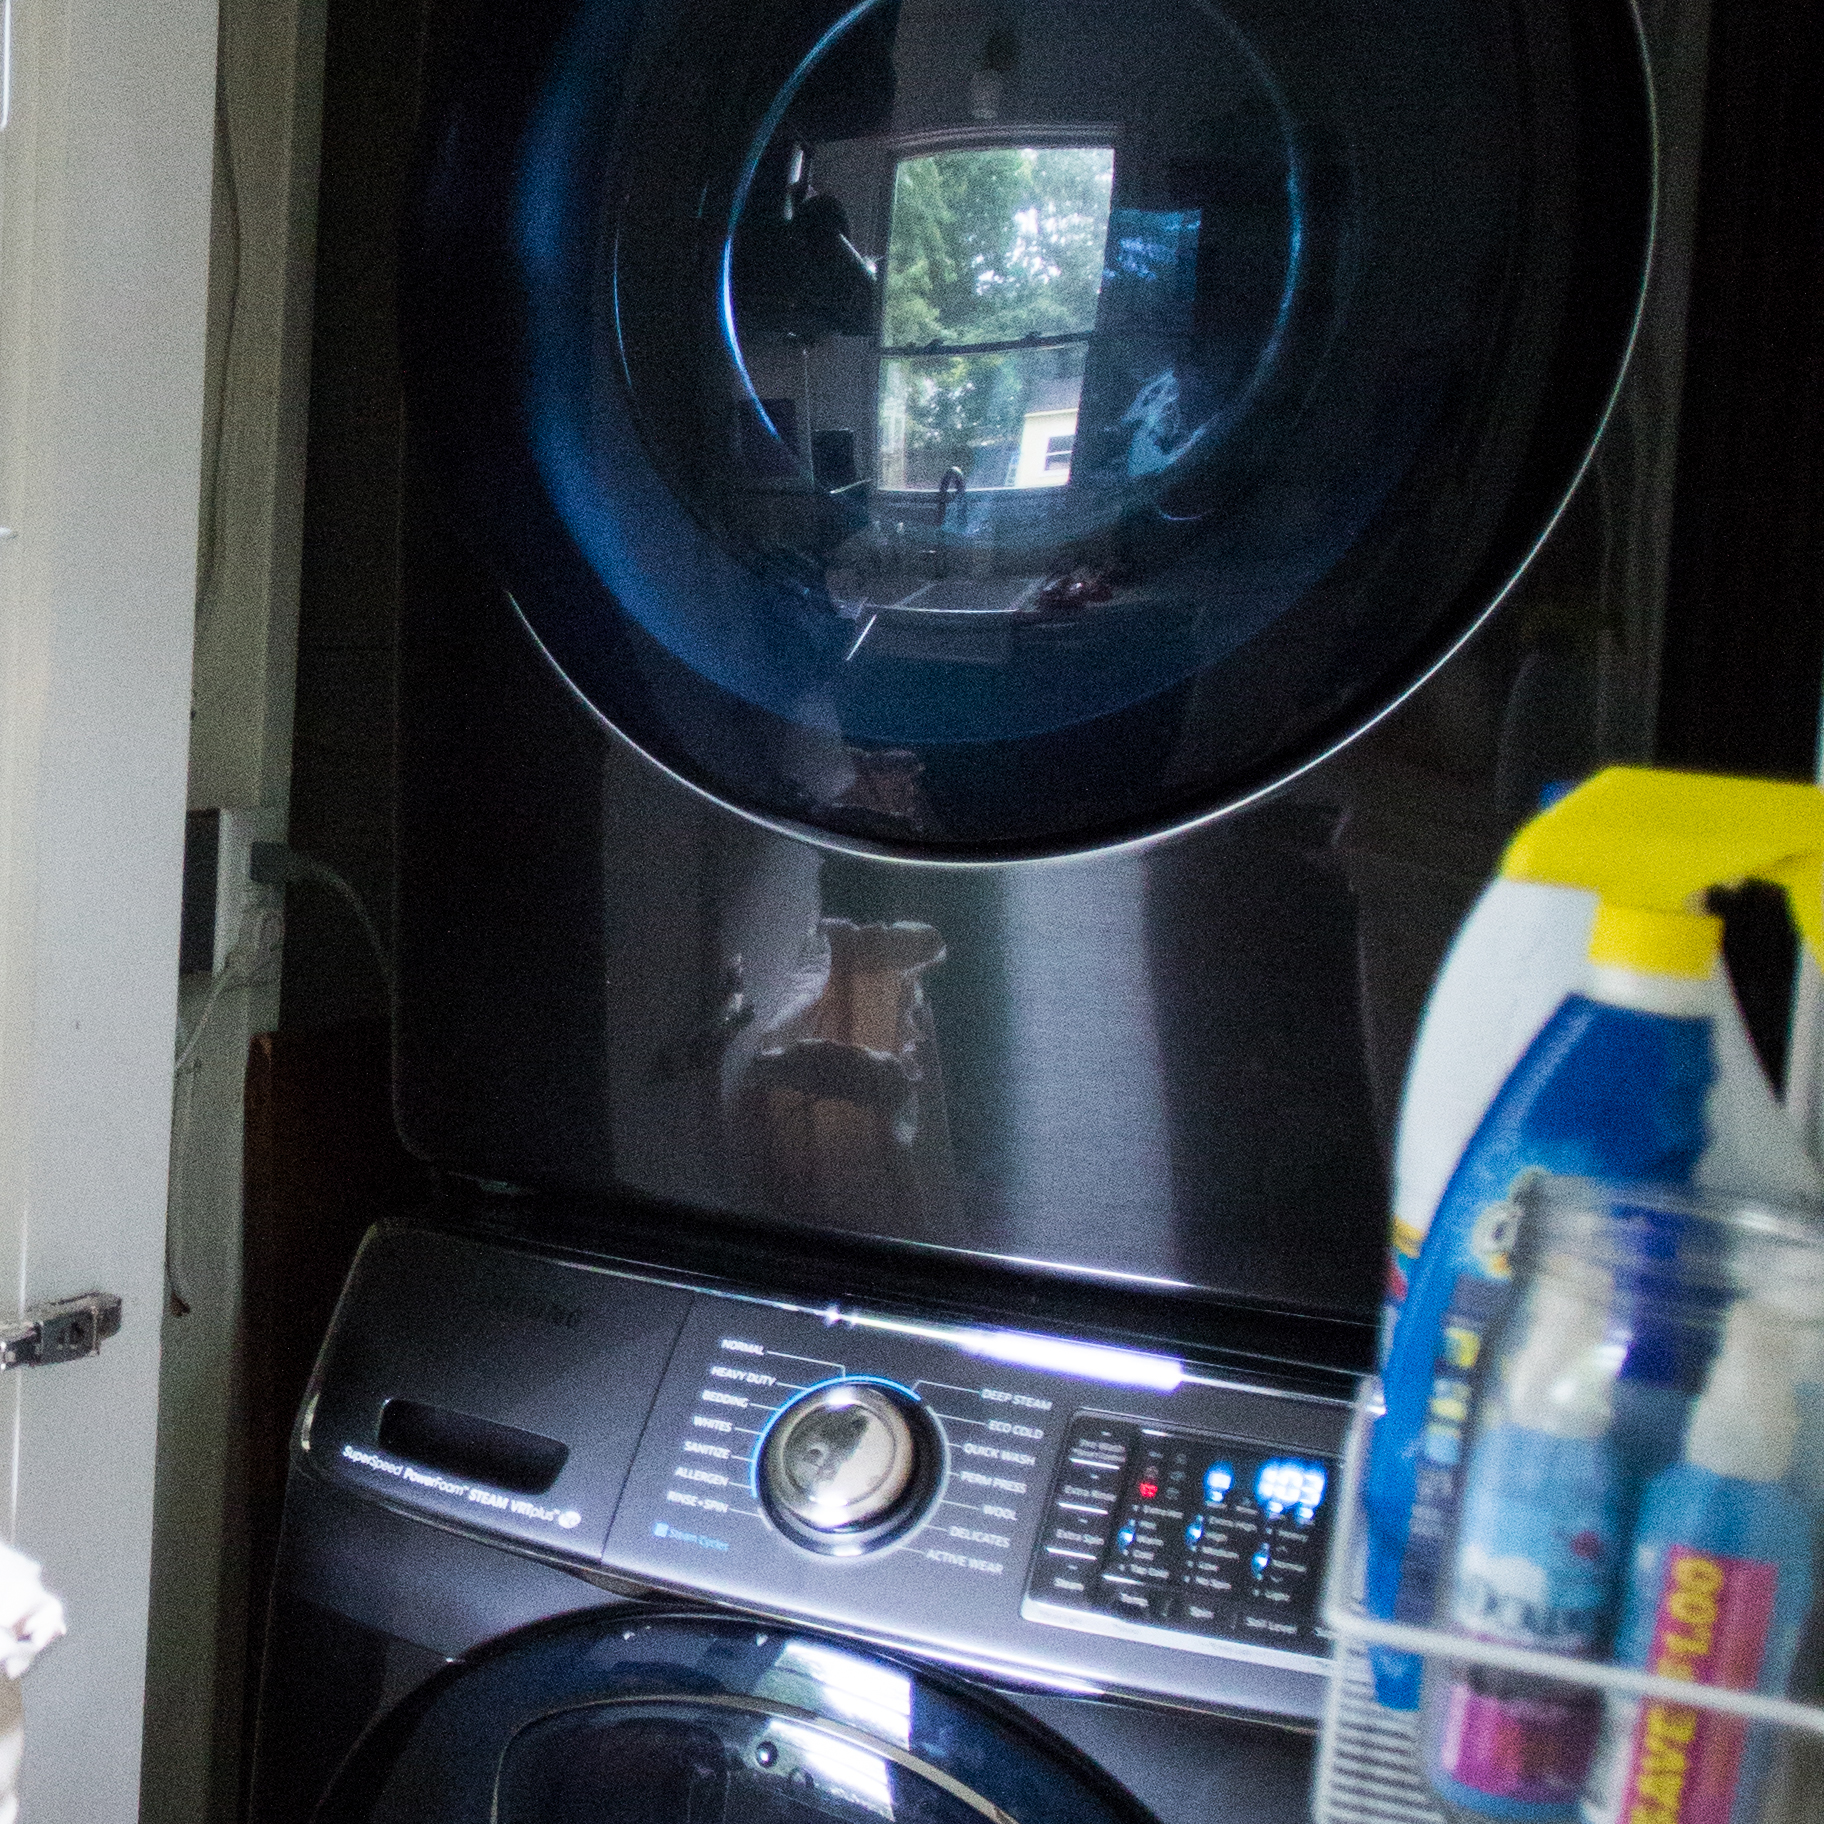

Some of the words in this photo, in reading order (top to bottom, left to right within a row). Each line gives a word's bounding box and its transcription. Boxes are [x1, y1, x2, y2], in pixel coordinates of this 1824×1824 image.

[721, 1338, 765, 1357] NORMAL
[710, 1365, 746, 1381] HEAVY
[747, 1373, 777, 1387] DUTY
[701, 1389, 750, 1410] BEDDING
[980, 1388, 1013, 1404] DEEP
[1012, 1393, 1053, 1412] STEAM
[692, 1415, 734, 1434] WHITES
[987, 1419, 1013, 1434] ECO
[1012, 1423, 1045, 1441] COLD
[683, 1439, 732, 1461] SANITIZE
[962, 1442, 999, 1460] QUICK
[999, 1450, 1037, 1467] WASH
[341, 1444, 404, 1476] SuperSpeed
[467, 1488, 510, 1510] STEAM
[674, 1466, 730, 1488] ALLERGEN
[959, 1470, 992, 1487] PERM
[992, 1477, 1028, 1495] PRESS
[1063, 1484, 1091, 1498] Extra
[1091, 1488, 1117, 1503] Rinse
[982, 1504, 1019, 1522] WOOL
[948, 1525, 1012, 1549] DELICATES
[1055, 1528, 1083, 1542] Extra
[1083, 1532, 1105, 1547] Spin
[923, 1549, 967, 1567] ACTIVE
[967, 1556, 1005, 1575] WEAR
[1245, 1616, 1267, 1629] Soil
[1267, 1620, 1298, 1635] Level
